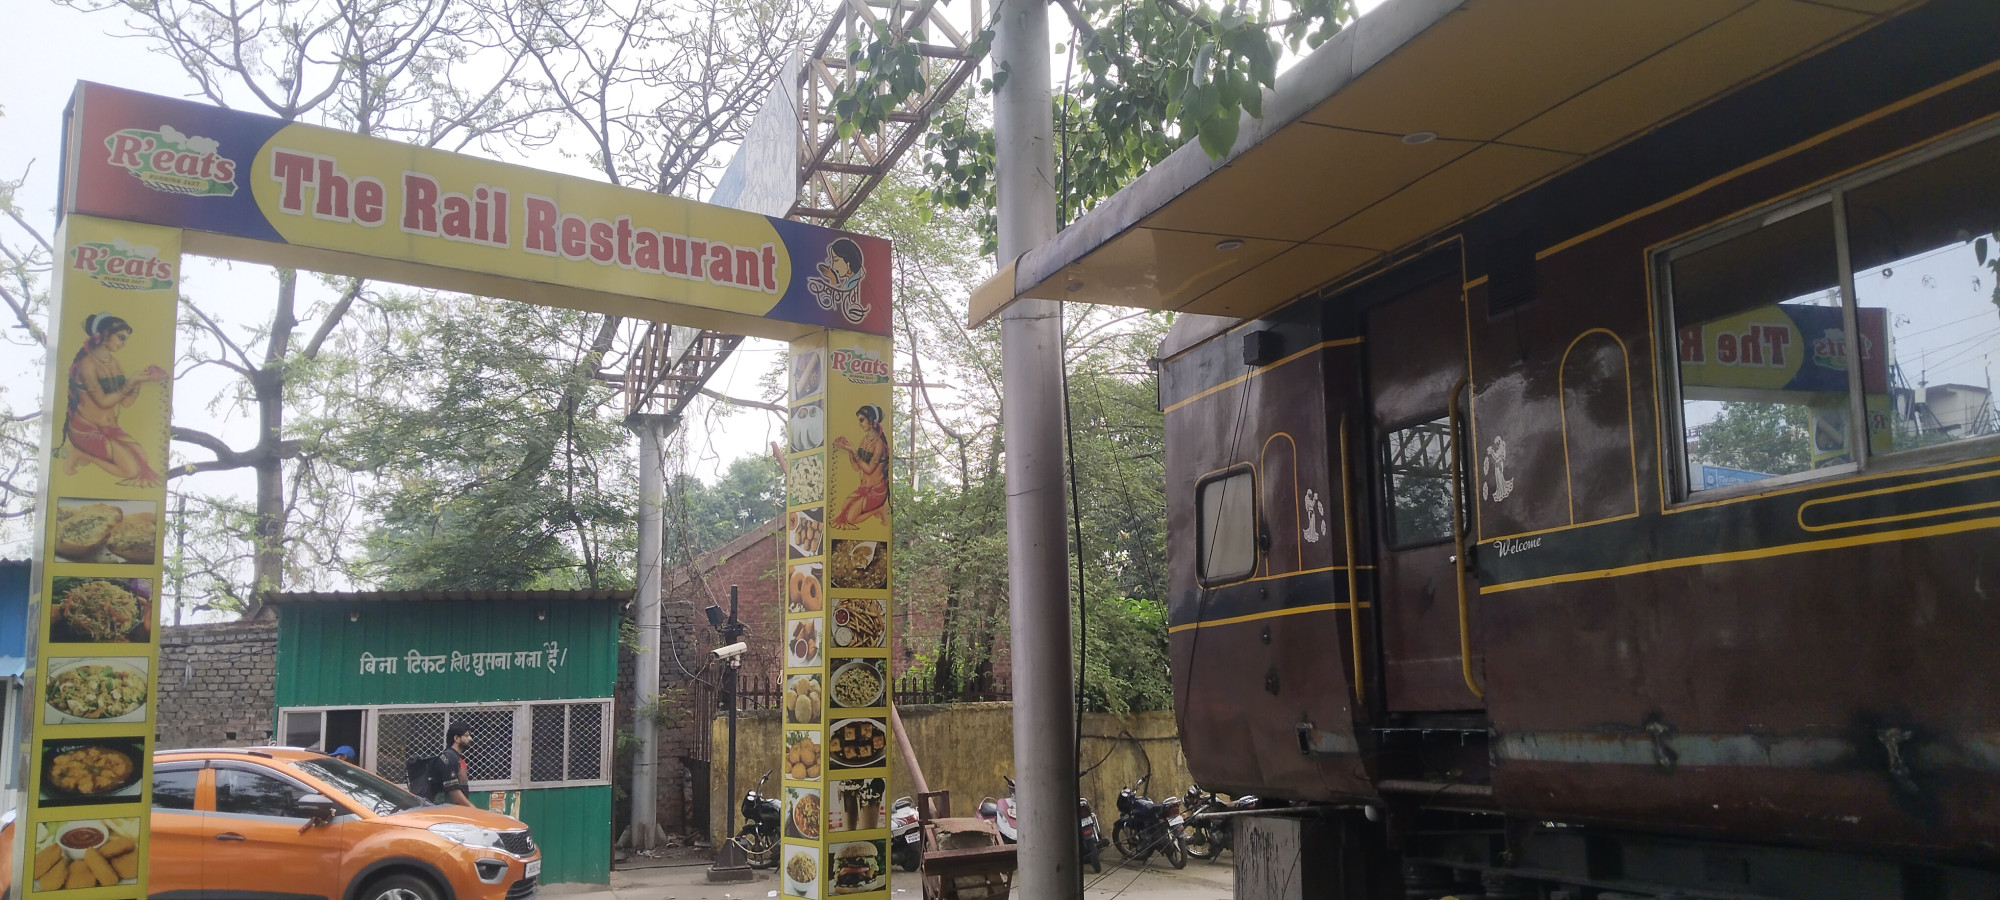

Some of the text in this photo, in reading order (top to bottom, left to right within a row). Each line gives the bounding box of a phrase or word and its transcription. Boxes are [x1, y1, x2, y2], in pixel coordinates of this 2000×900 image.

[273, 151, 777, 291] The Rail Restaurant
[1493, 538, 1542, 558] Welcome
[359, 651, 398, 675] बिना
[404, 649, 447, 673] टिकट
[450, 650, 471, 672] लिए
[472, 652, 512, 676] घुसना
[514, 650, 542, 669] मना
